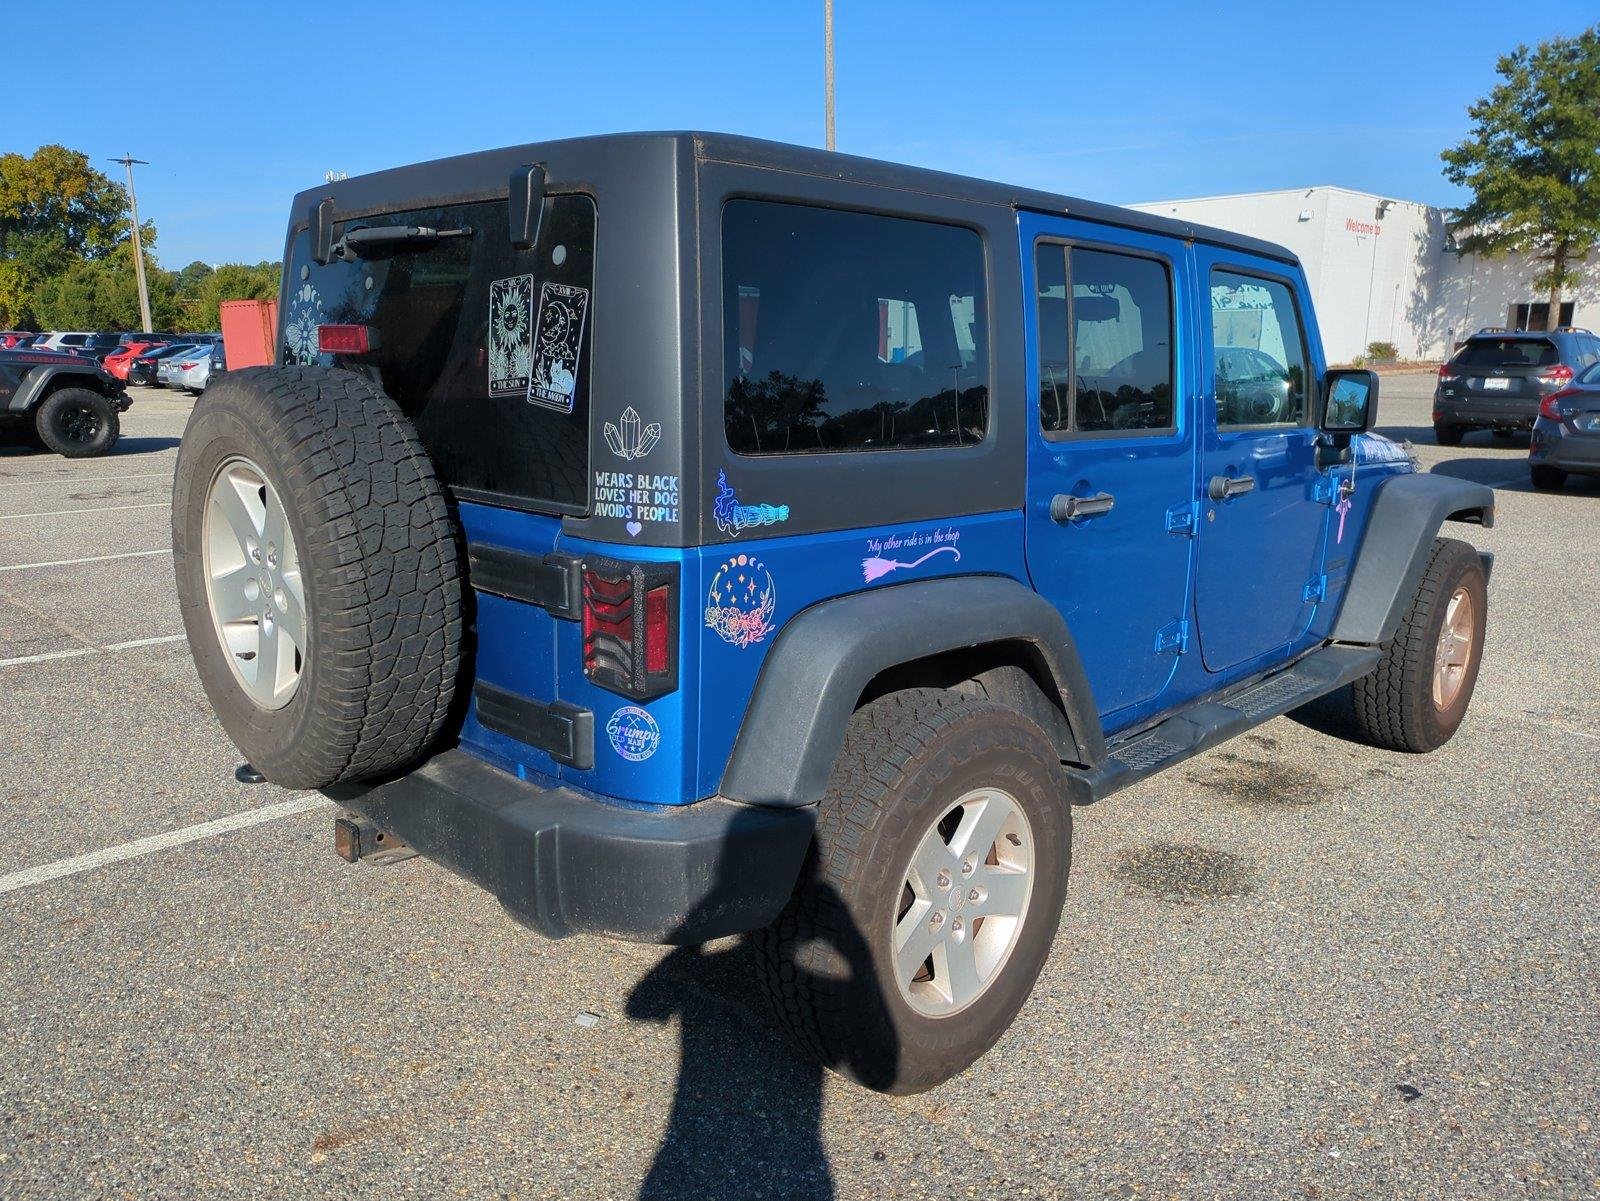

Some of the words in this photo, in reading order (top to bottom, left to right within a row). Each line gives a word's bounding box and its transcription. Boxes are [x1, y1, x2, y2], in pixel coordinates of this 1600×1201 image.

[1345, 217, 1374, 234] Welcome
[1374, 224, 1381, 236] to
[497, 380, 509, 390] THE
[509, 378, 521, 388] SUN
[535, 387, 547, 399] THE
[547, 390, 565, 404] MOON
[595, 471, 633, 489] WEARS
[637, 474, 679, 492] BLACK
[595, 487, 626, 503] LOVES
[629, 490, 650, 504] HER
[654, 491, 679, 506] DOG
[594, 502, 633, 519] AVOIDS
[637, 505, 679, 523] PEOPLE
[867, 538, 883, 559] My
[883, 533, 903, 551] other
[903, 531, 918, 547] ride
[918, 533, 924, 546] is
[924, 533, 932, 545] in
[933, 528, 944, 543] the
[944, 526, 960, 547] shop
[605, 717, 661, 749] Grumpy
[611, 734, 625, 743] OLD
